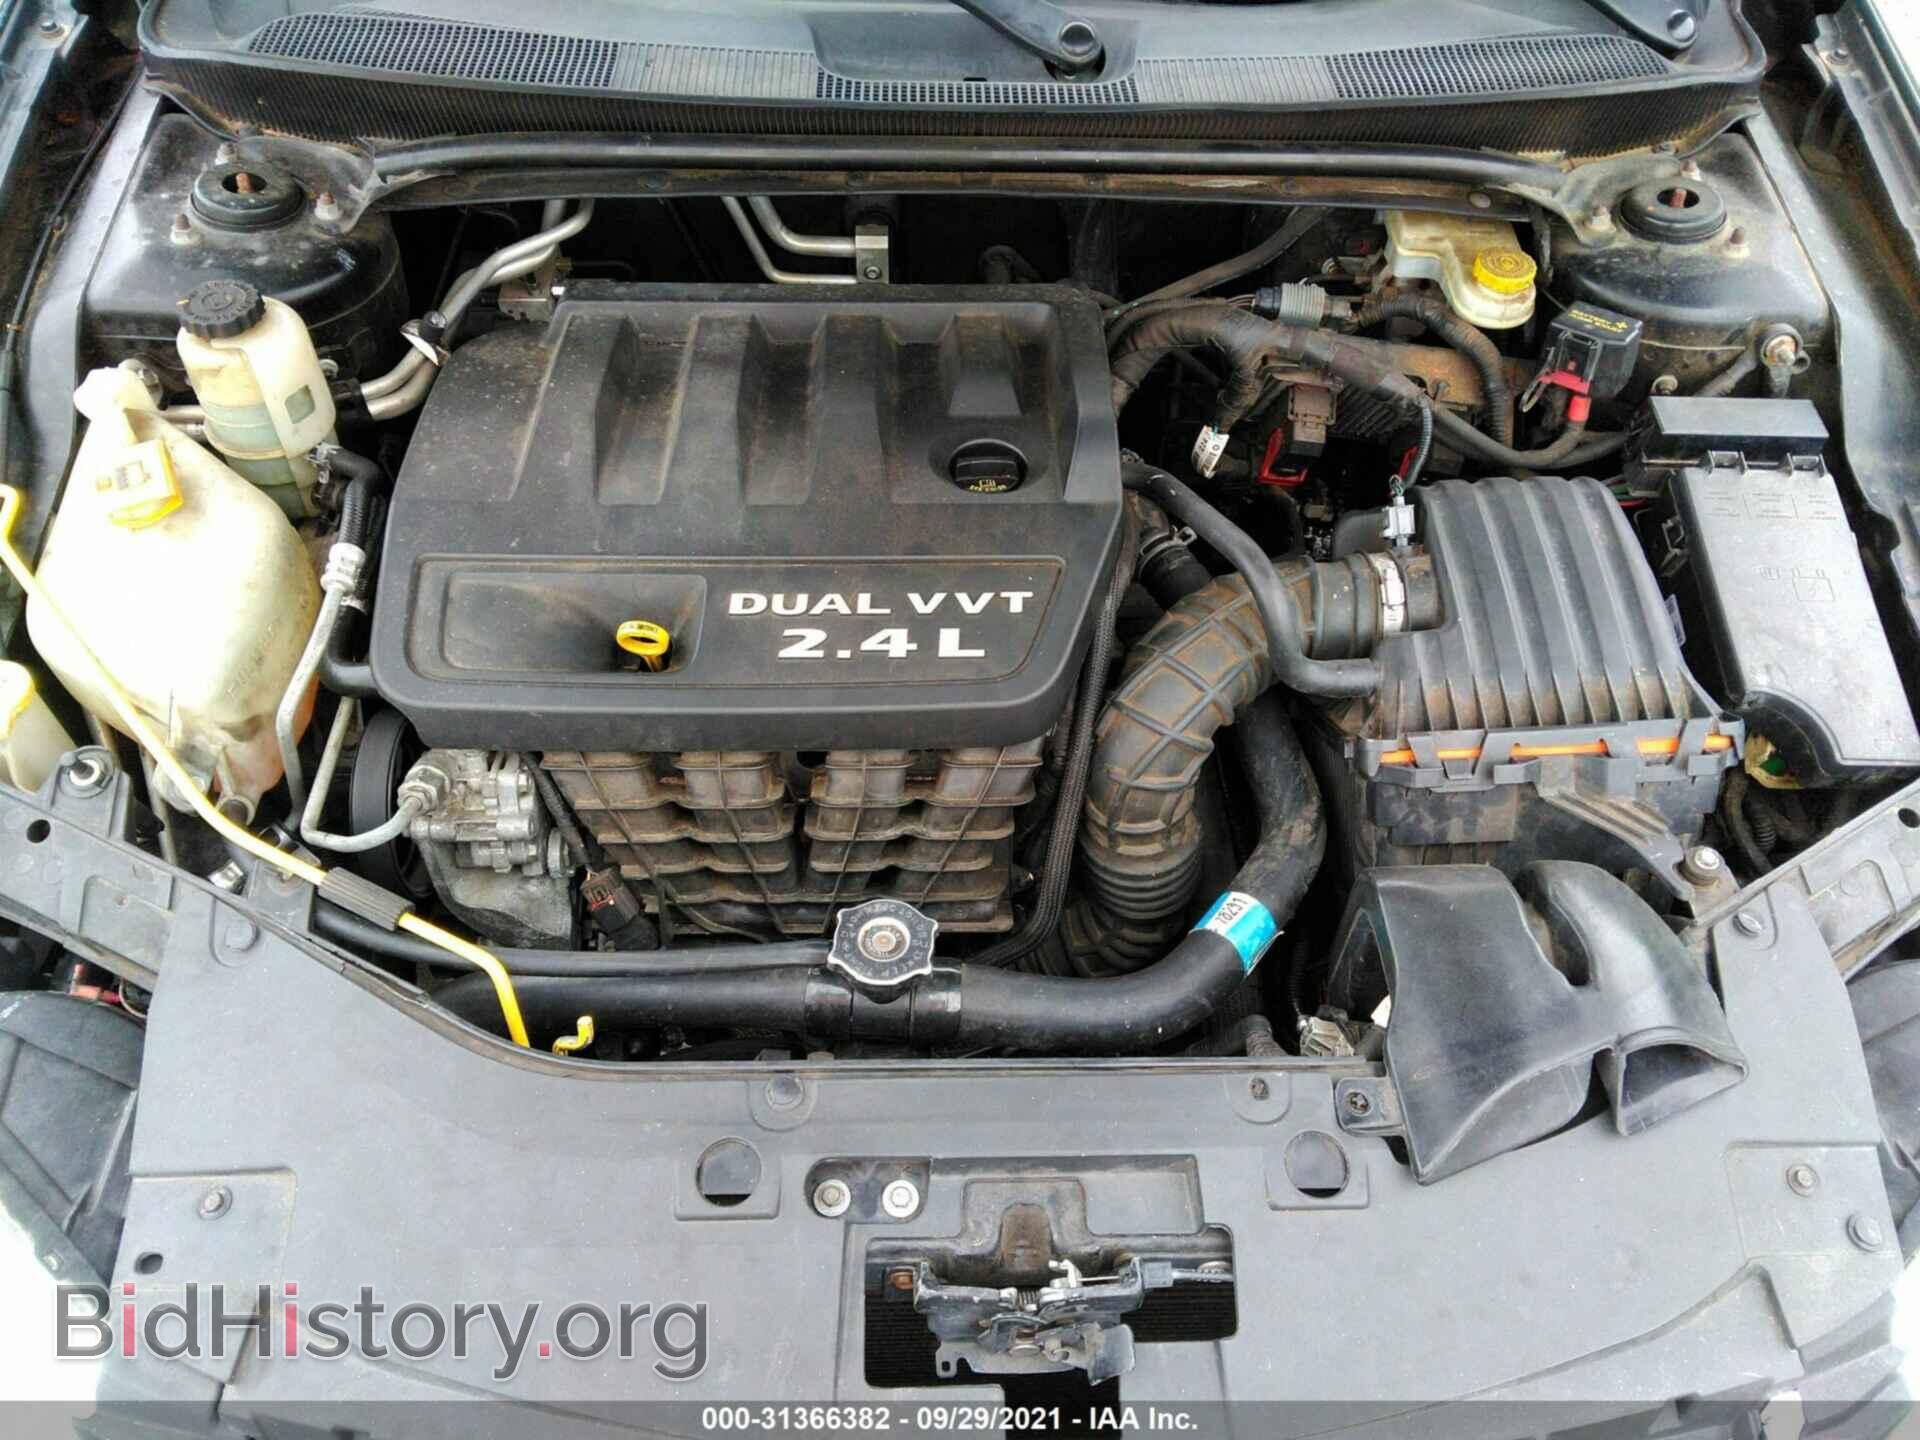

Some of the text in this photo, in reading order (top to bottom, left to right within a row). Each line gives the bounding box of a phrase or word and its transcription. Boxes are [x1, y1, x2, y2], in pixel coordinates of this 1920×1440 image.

[728, 591, 1033, 615] DUAL VVT
[778, 628, 985, 658] 2.4 L
